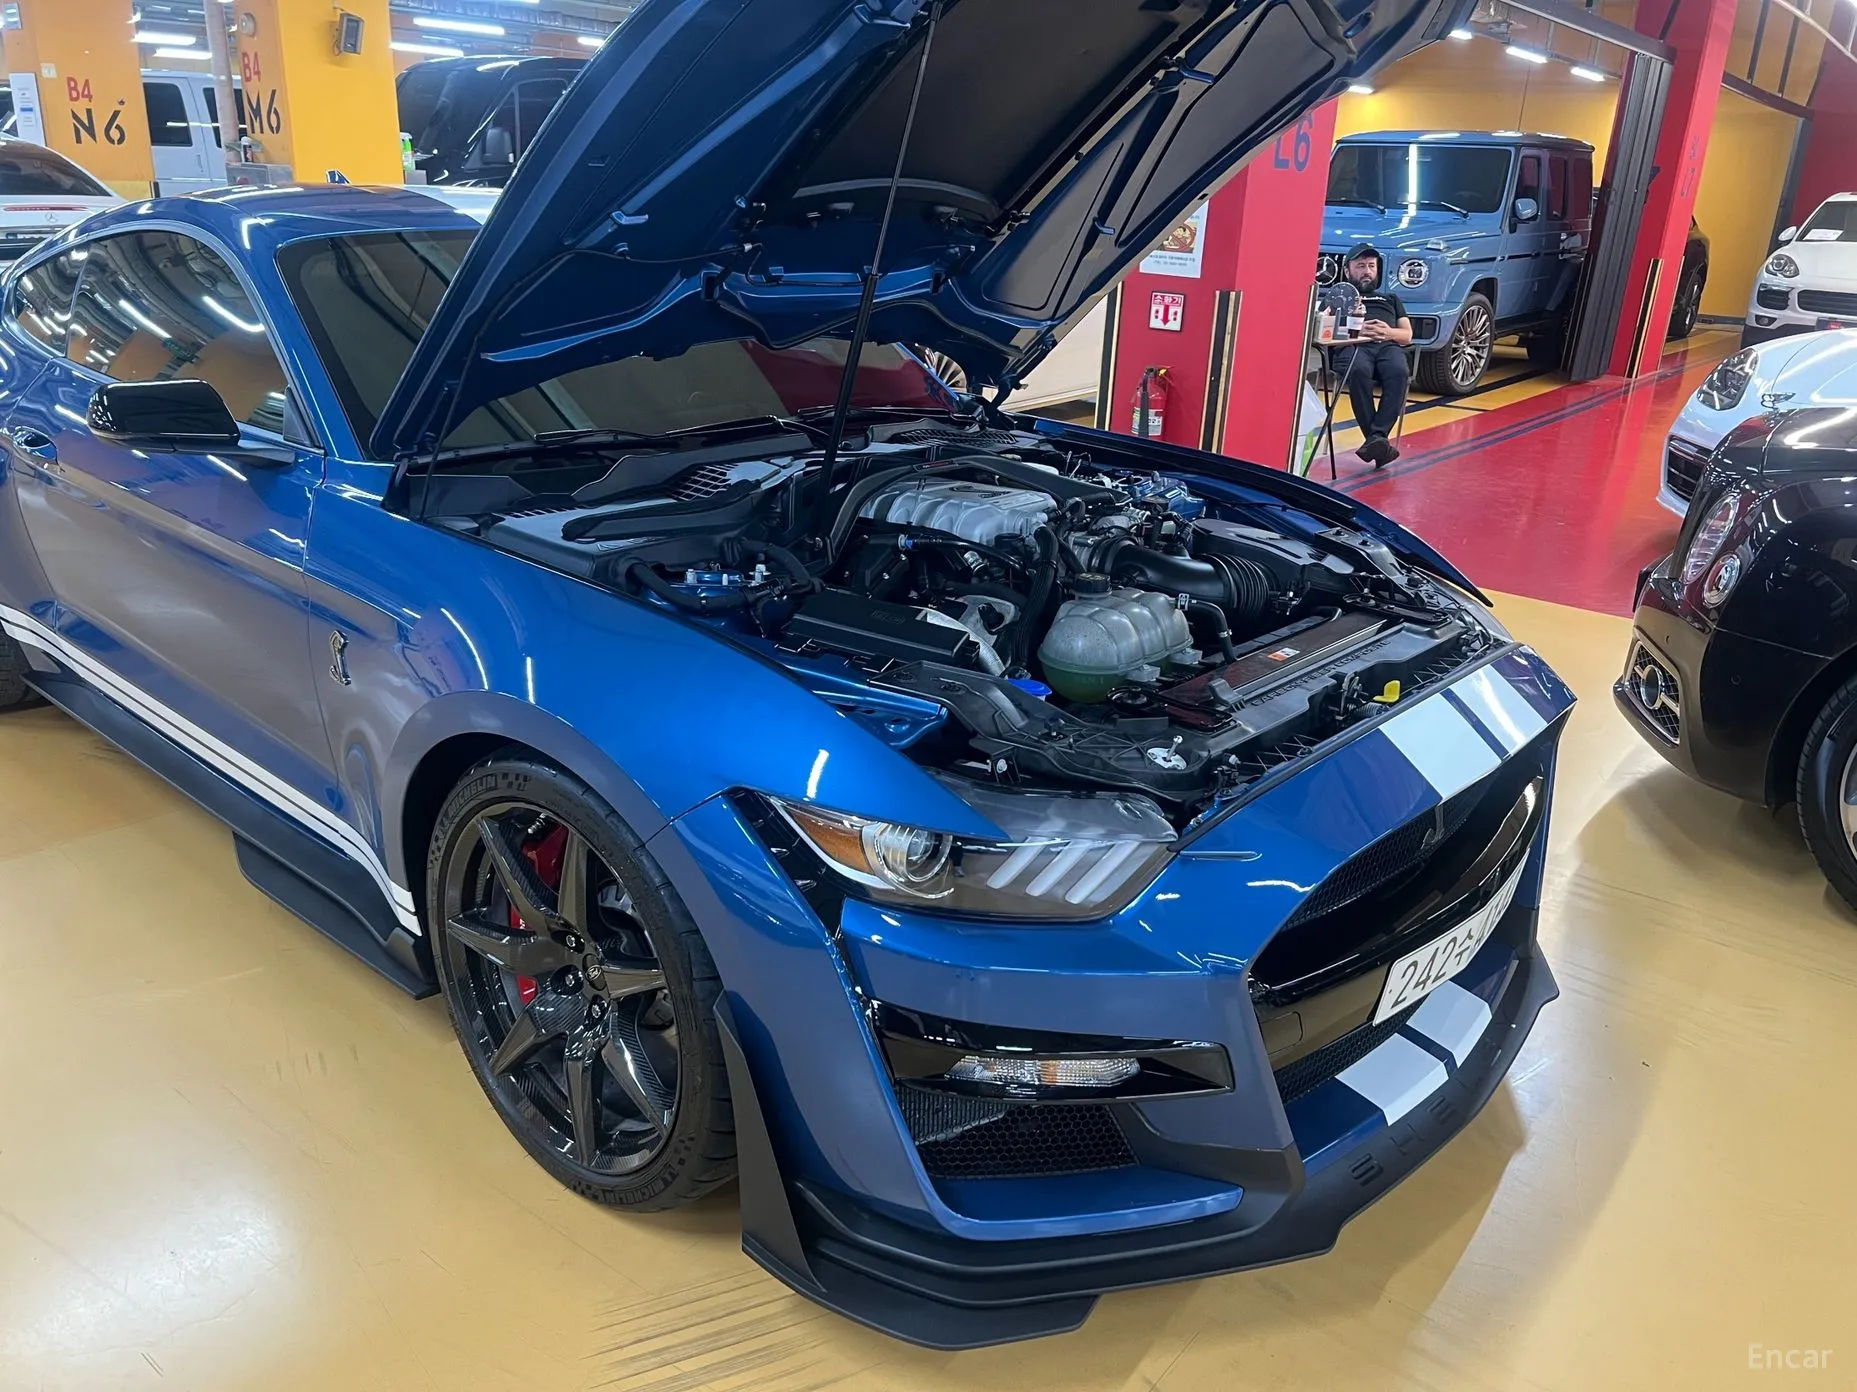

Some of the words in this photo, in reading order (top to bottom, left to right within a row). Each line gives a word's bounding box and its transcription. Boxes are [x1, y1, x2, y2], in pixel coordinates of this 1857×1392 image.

[242, 52, 261, 82] B4
[66, 76, 93, 103] B4
[245, 88, 281, 135] M6
[447, 773, 497, 819] MICHELIN
